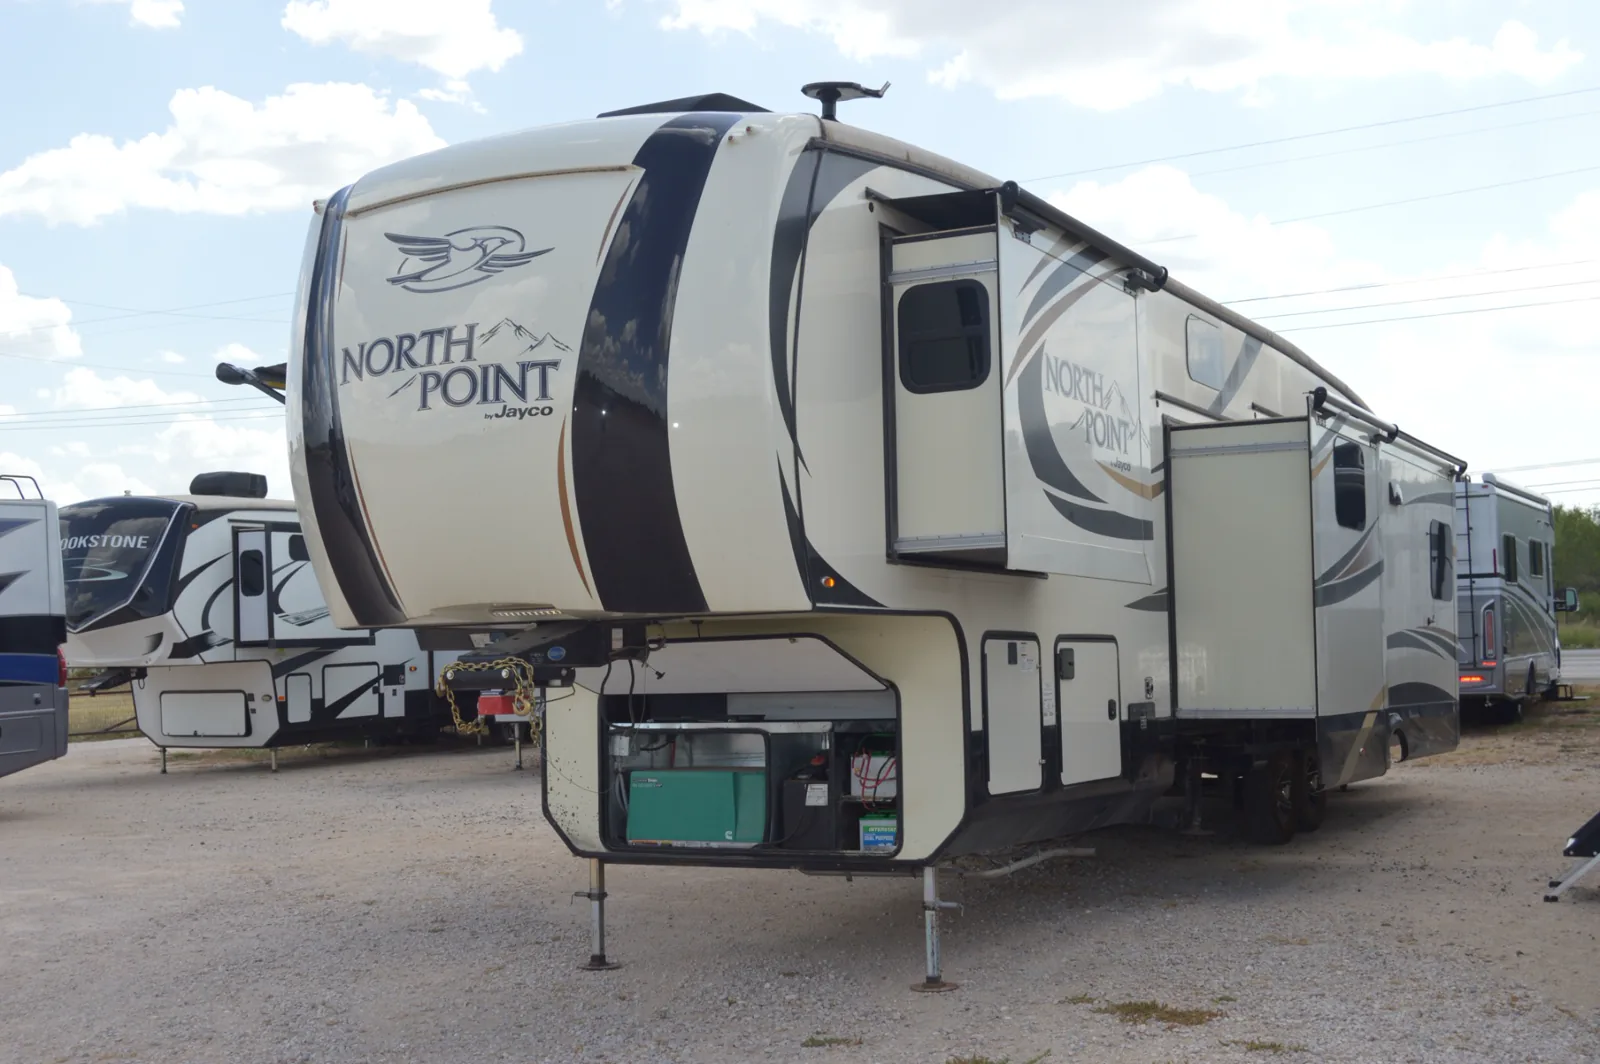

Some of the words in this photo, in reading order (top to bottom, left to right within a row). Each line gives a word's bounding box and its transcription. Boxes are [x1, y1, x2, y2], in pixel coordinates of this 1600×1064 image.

[340, 322, 480, 386] NORTH
[417, 359, 562, 411] POINT
[1044, 352, 1104, 409] NORTH
[494, 404, 554, 420] Jayco
[1084, 406, 1130, 455] POINT
[1113, 456, 1132, 472] Jayco
